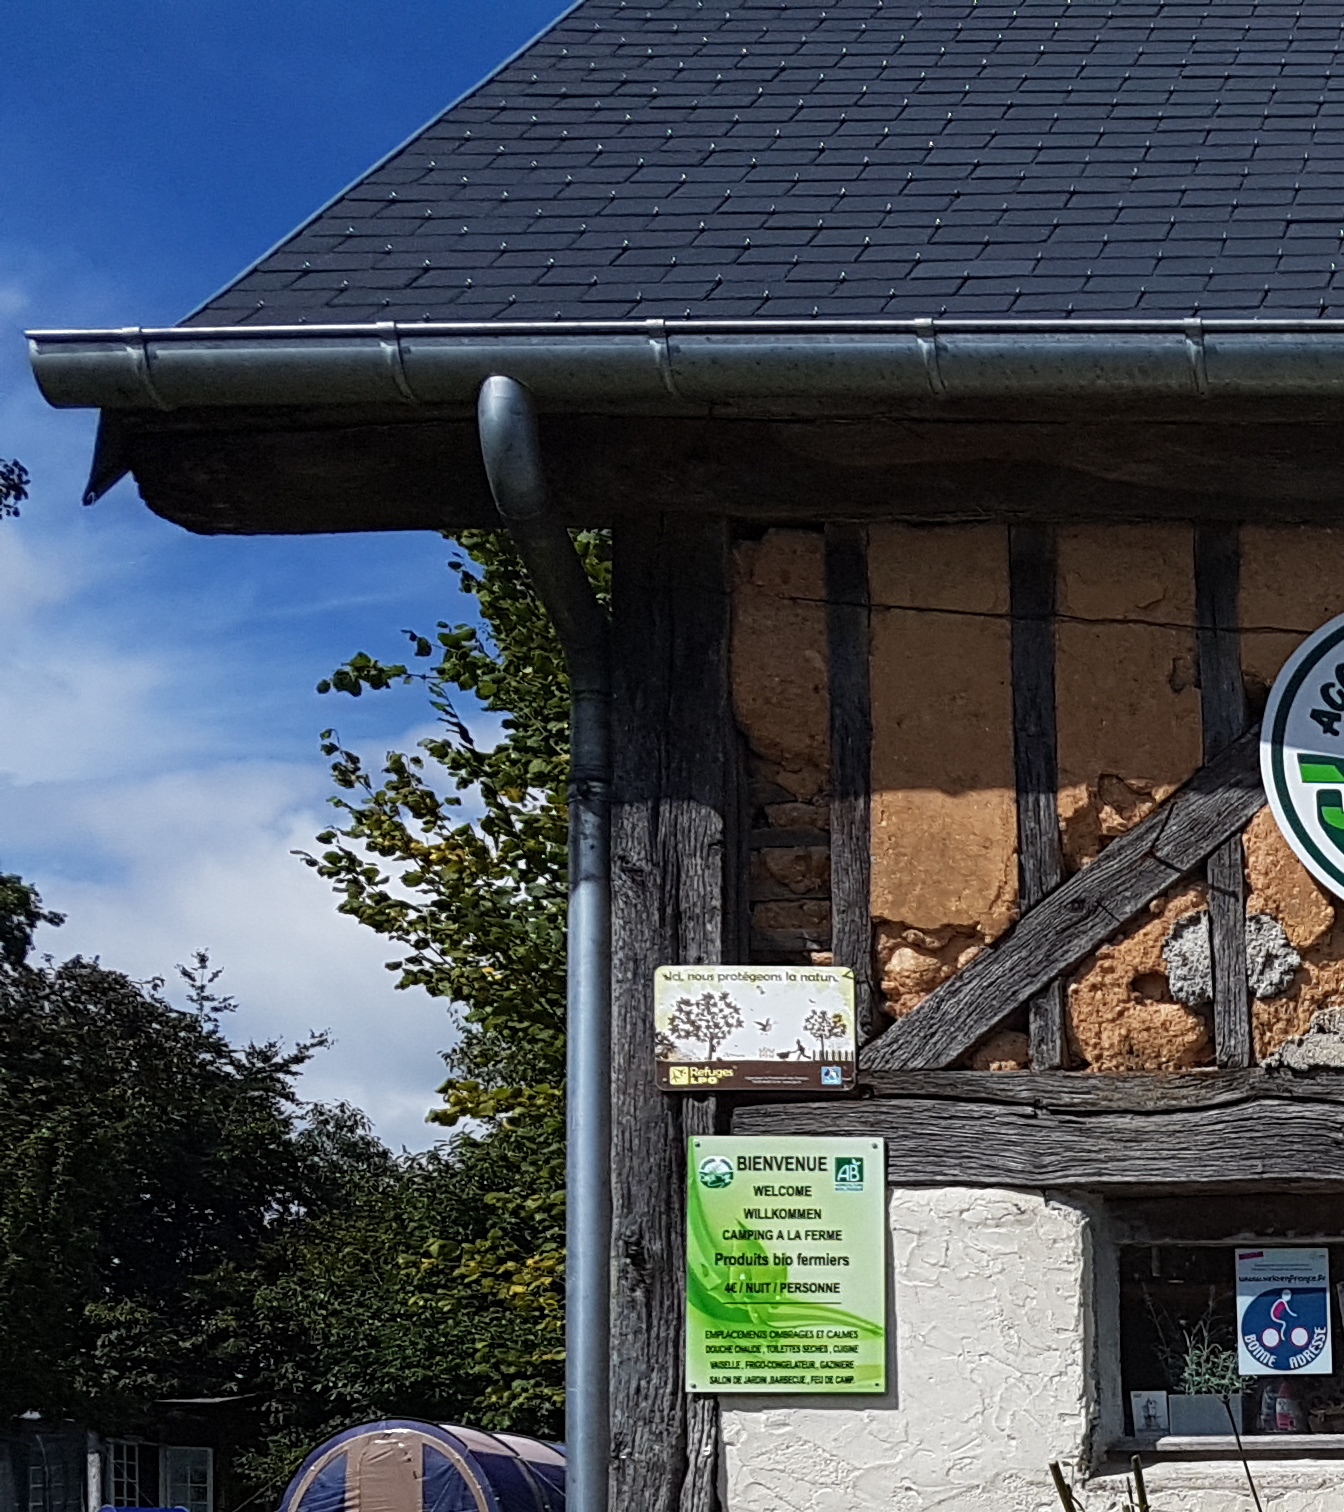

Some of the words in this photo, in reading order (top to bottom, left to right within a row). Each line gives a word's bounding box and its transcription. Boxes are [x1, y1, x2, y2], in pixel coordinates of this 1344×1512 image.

[687, 973, 714, 982] nous
[717, 971, 782, 985] protégeons
[785, 971, 798, 982] la
[689, 1066, 734, 1081] Refuges
[689, 1077, 718, 1085] LPO
[737, 1156, 828, 1172] BIENVENUE
[837, 1164, 861, 1182] AB
[753, 1185, 813, 1197] WELCOME
[743, 1208, 822, 1220] WILLKOMMEN
[722, 1229, 773, 1241] CAMPING
[776, 1229, 785, 1241] A
[787, 1229, 802, 1241] LA
[804, 1229, 843, 1241] FERME
[714, 1253, 769, 1266] Produits
[772, 1253, 793, 1266] bio
[797, 1253, 850, 1266] fermiers
[724, 1282, 738, 1294] 4€
[745, 1282, 771, 1294] NUIT
[780, 1282, 841, 1294] PERSONNE
[816, 1330, 825, 1340] ET
[826, 1330, 859, 1340] CALMES
[1244, 1333, 1278, 1368] BONNE
[1288, 1326, 1327, 1369] ADRESSE
[709, 1375, 732, 1385] SALON
[732, 1375, 742, 1385] DE
[811, 1375, 824, 1385] FEU
[824, 1375, 834, 1385] DE
